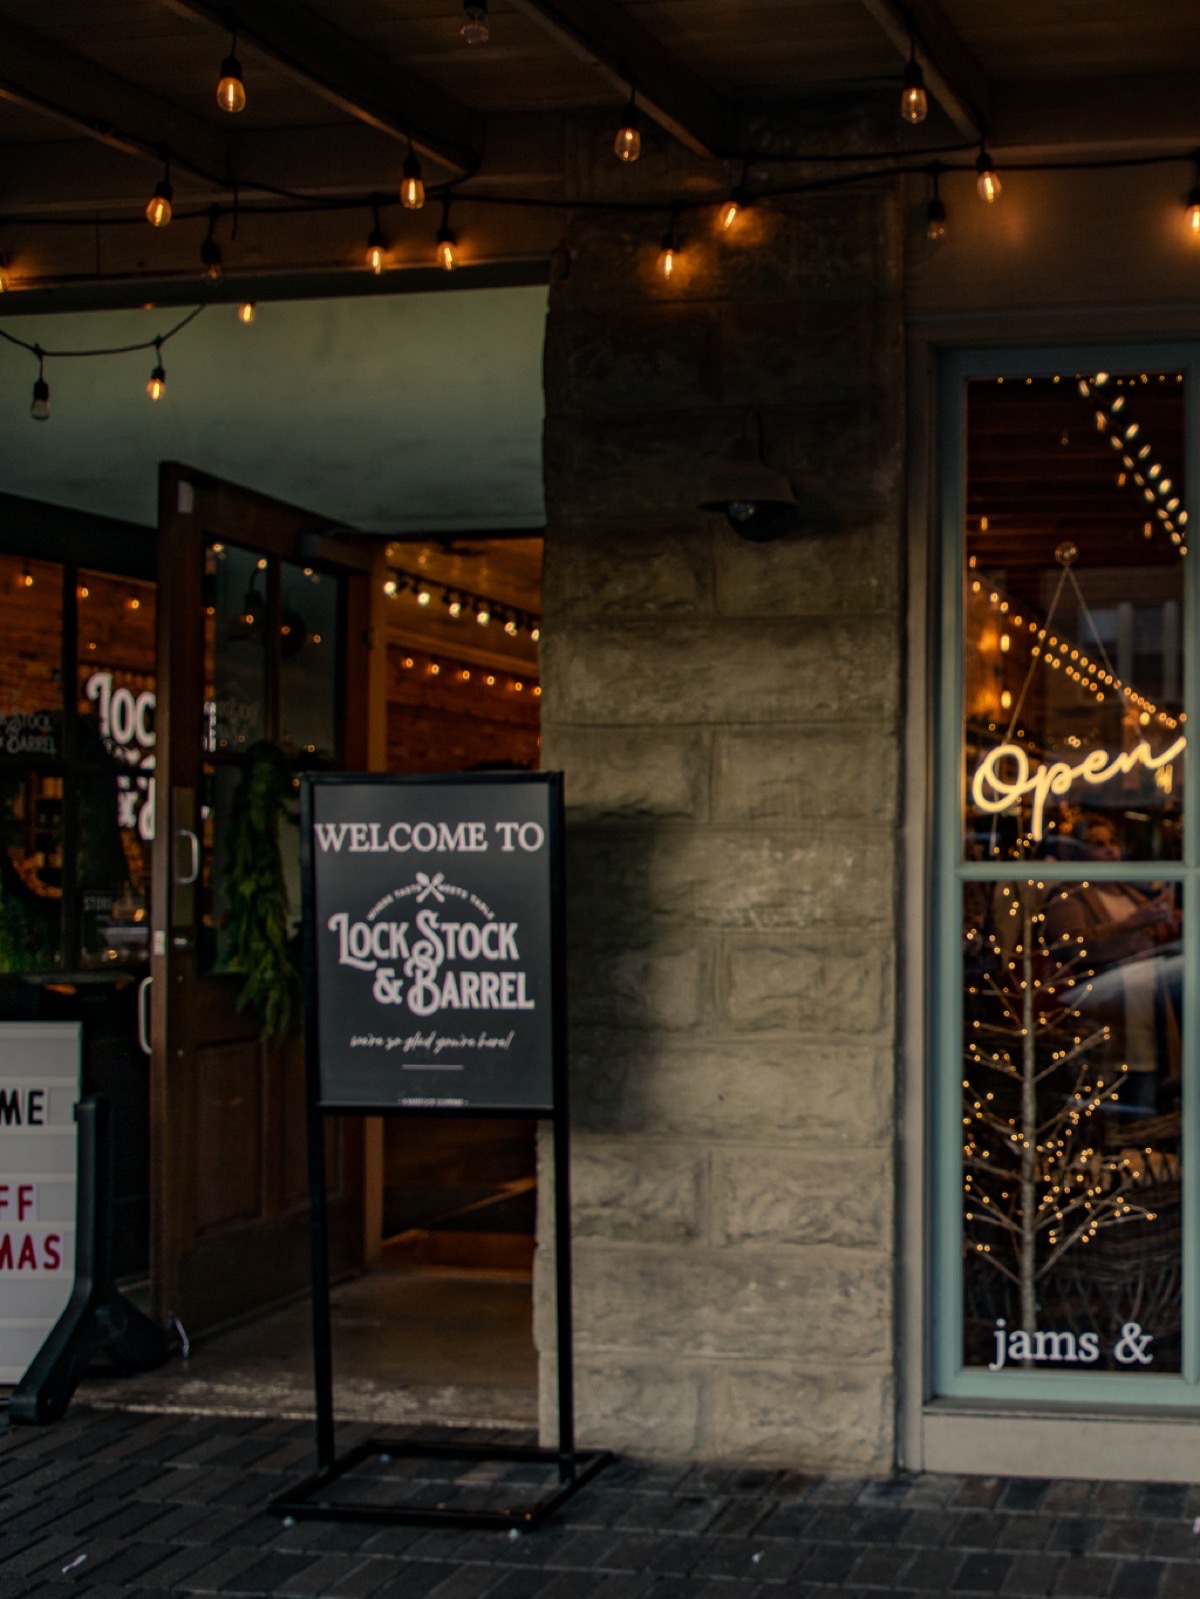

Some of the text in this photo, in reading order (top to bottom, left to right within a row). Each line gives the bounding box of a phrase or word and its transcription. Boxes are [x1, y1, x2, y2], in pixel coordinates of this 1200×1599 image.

[972, 737, 1188, 842] Open
[315, 821, 545, 852] WELCOME TO
[372, 955, 535, 1016] & BARREL
[402, 1030, 437, 1053] glad
[989, 1319, 1100, 1372] jams
[1113, 1321, 1154, 1367] &
